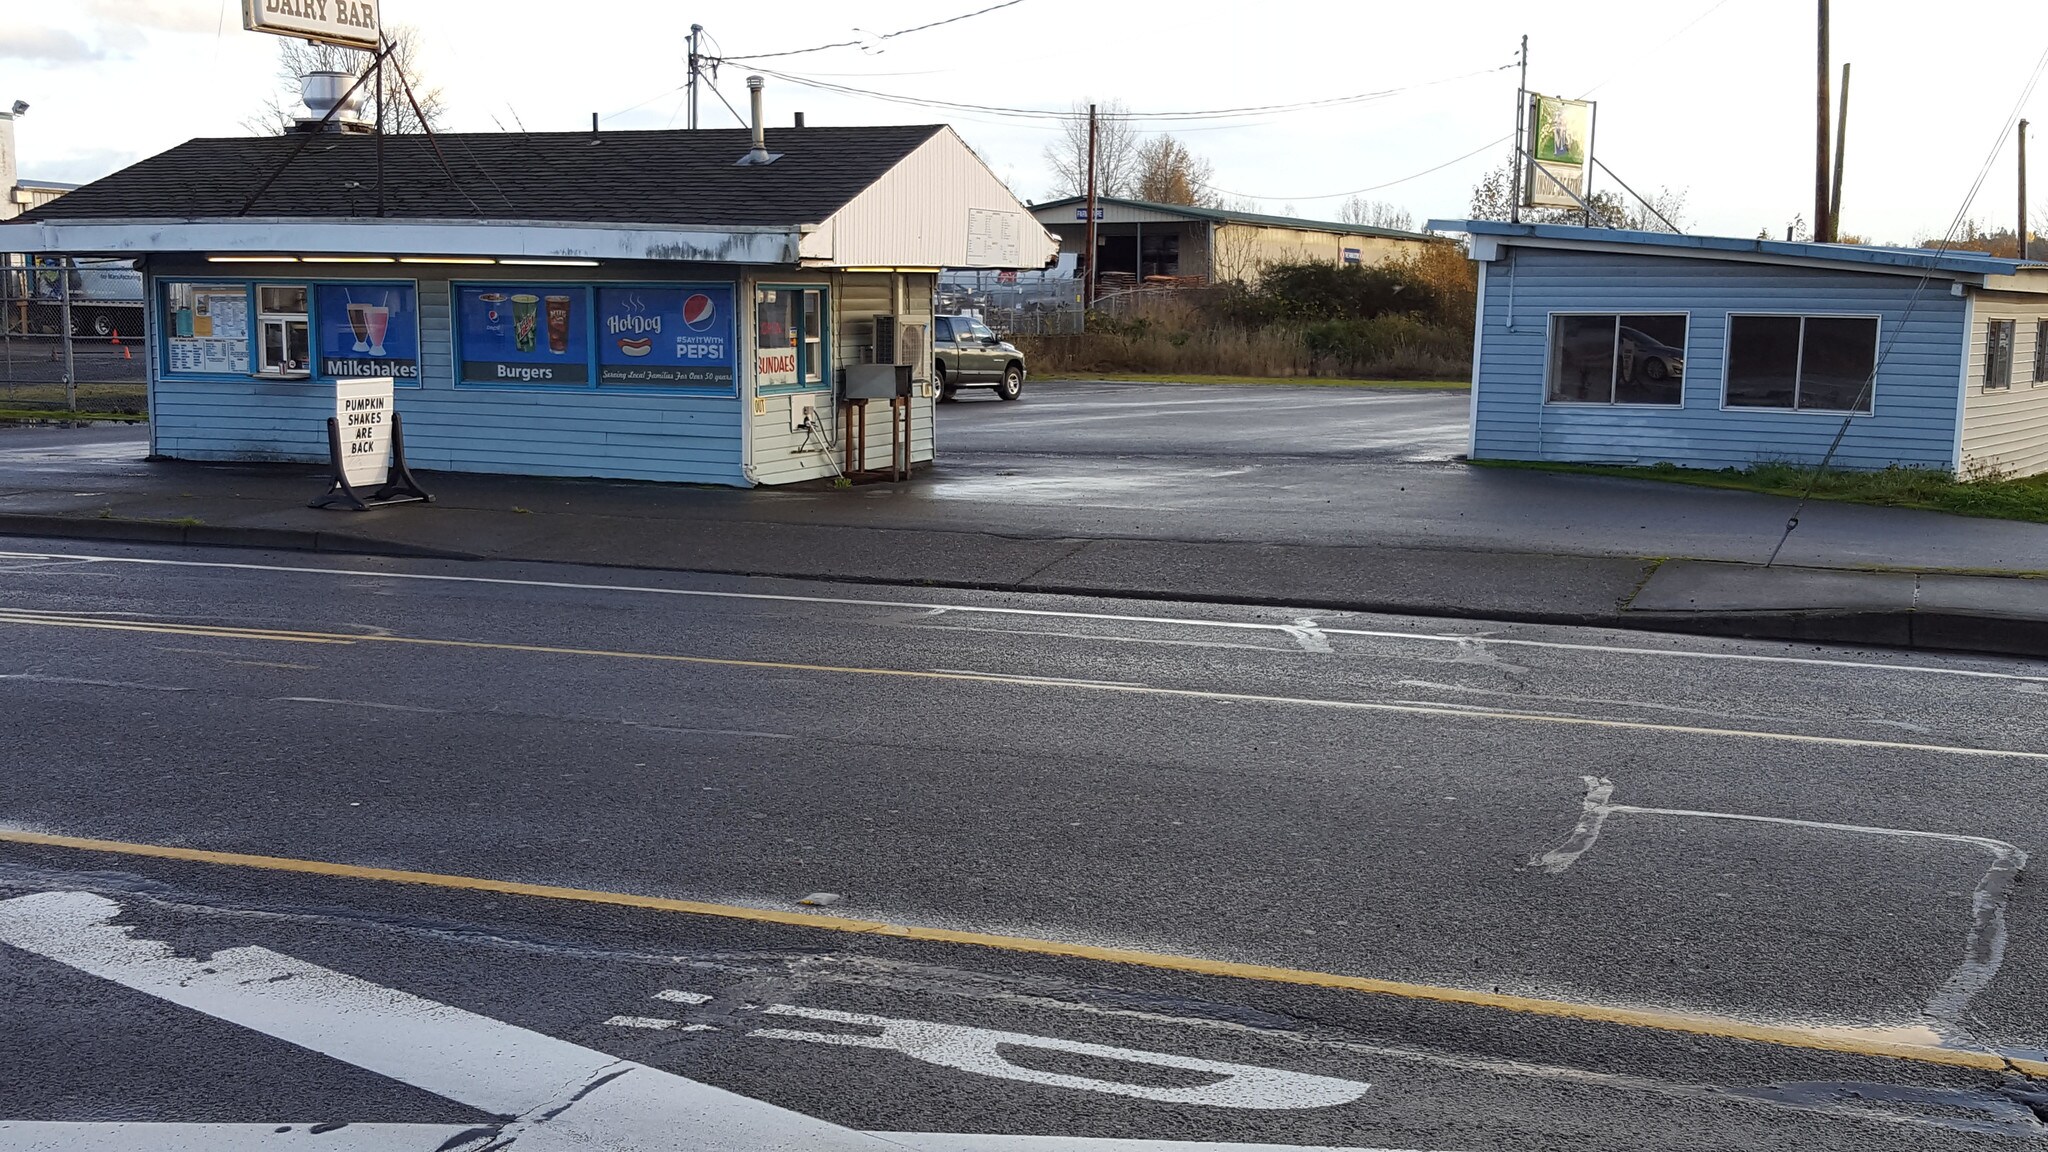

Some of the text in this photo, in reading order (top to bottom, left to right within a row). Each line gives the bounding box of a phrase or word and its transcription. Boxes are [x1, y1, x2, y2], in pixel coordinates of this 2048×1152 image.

[266, 0, 376, 30] DAIRY BAR
[676, 345, 724, 359] PEPSI
[327, 360, 418, 377] Milkshakes
[759, 355, 795, 375] SUNDAES
[497, 364, 553, 381] Burgers
[602, 370, 627, 380] Serving
[627, 371, 646, 379] Local
[646, 370, 674, 380] Families
[675, 371, 687, 381] For
[704, 372, 714, 380] 50
[345, 397, 385, 412] PUMPKIN
[348, 412, 382, 426] SHAKES
[355, 427, 373, 440] ARE
[351, 441, 374, 454] BACK
